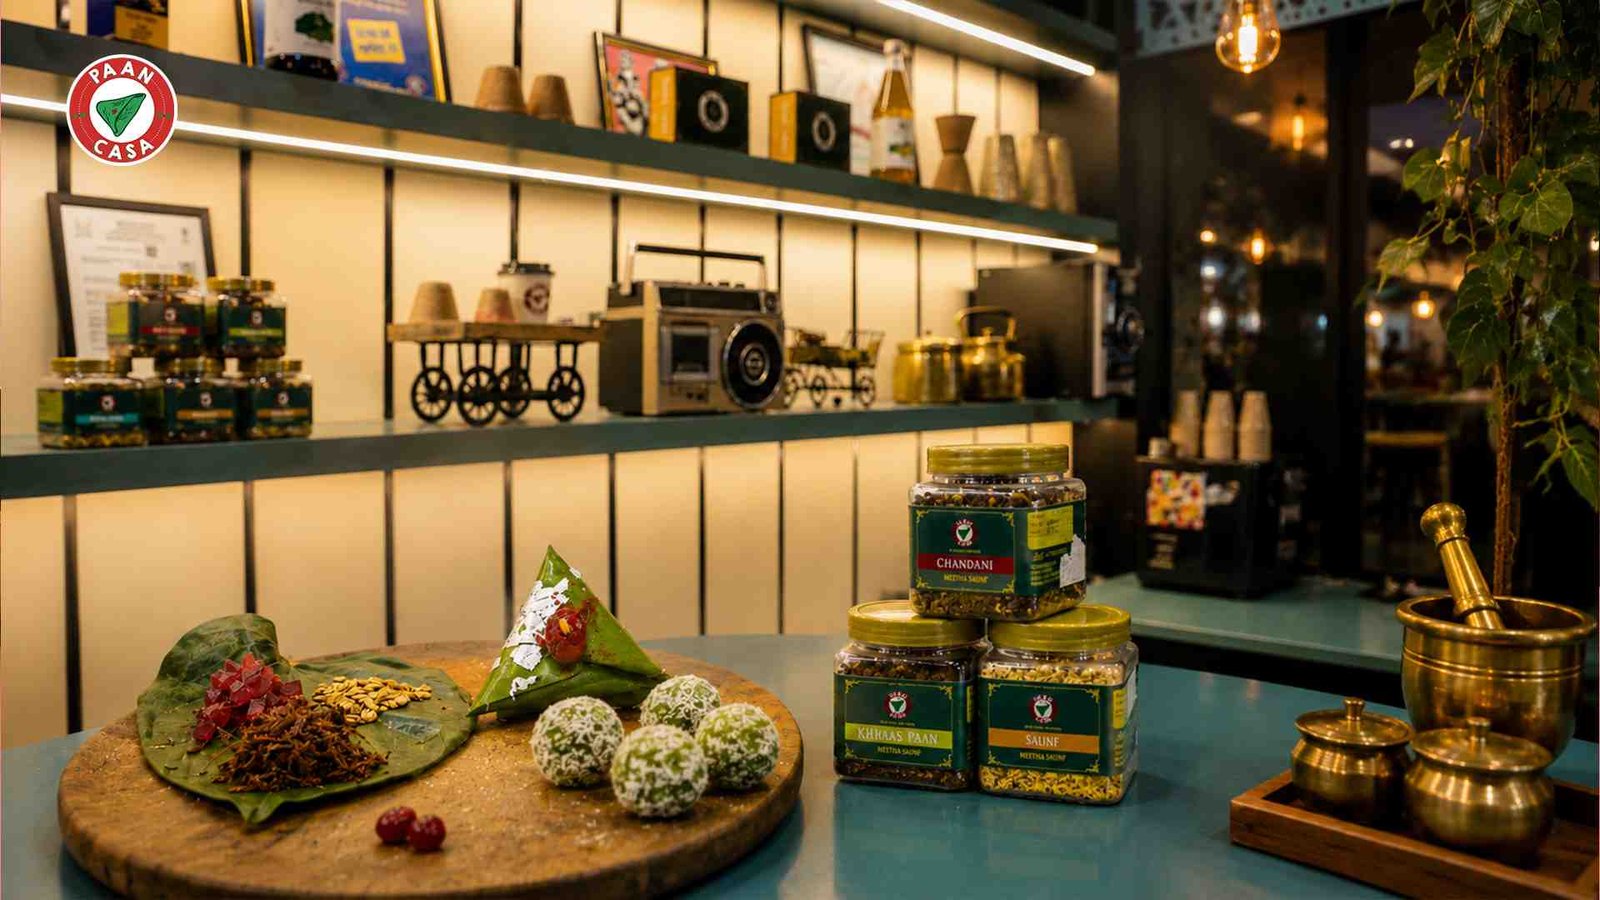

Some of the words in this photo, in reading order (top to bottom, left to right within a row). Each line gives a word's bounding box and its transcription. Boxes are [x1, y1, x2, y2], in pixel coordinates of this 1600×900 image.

[936, 557, 993, 570] CHANDANI
[907, 731, 938, 745] PAAN
[1025, 734, 1060, 747] SAUNF
